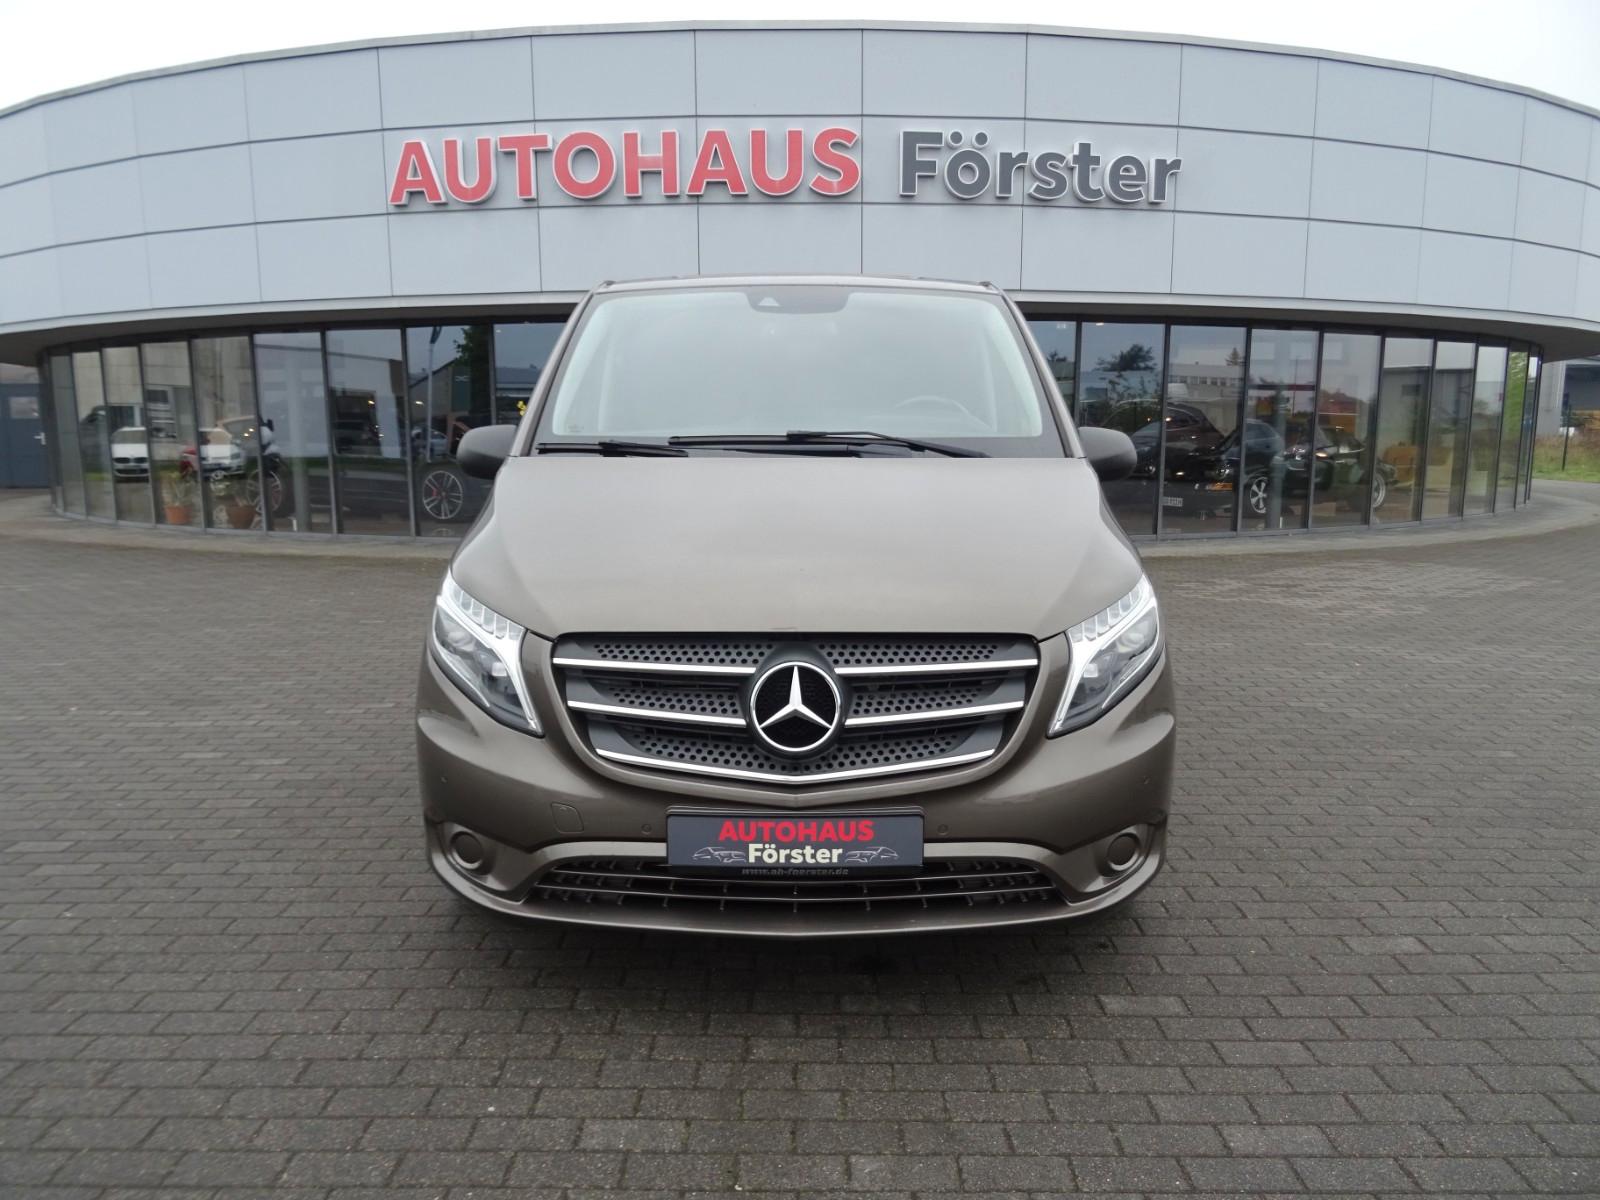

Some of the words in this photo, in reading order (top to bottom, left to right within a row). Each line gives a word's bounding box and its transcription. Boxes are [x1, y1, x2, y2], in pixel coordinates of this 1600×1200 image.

[389, 127, 861, 205] AUTOHAUS
[899, 130, 1182, 203] Förster
[719, 820, 875, 842] AUTOHAUS
[748, 844, 843, 864] Förster
